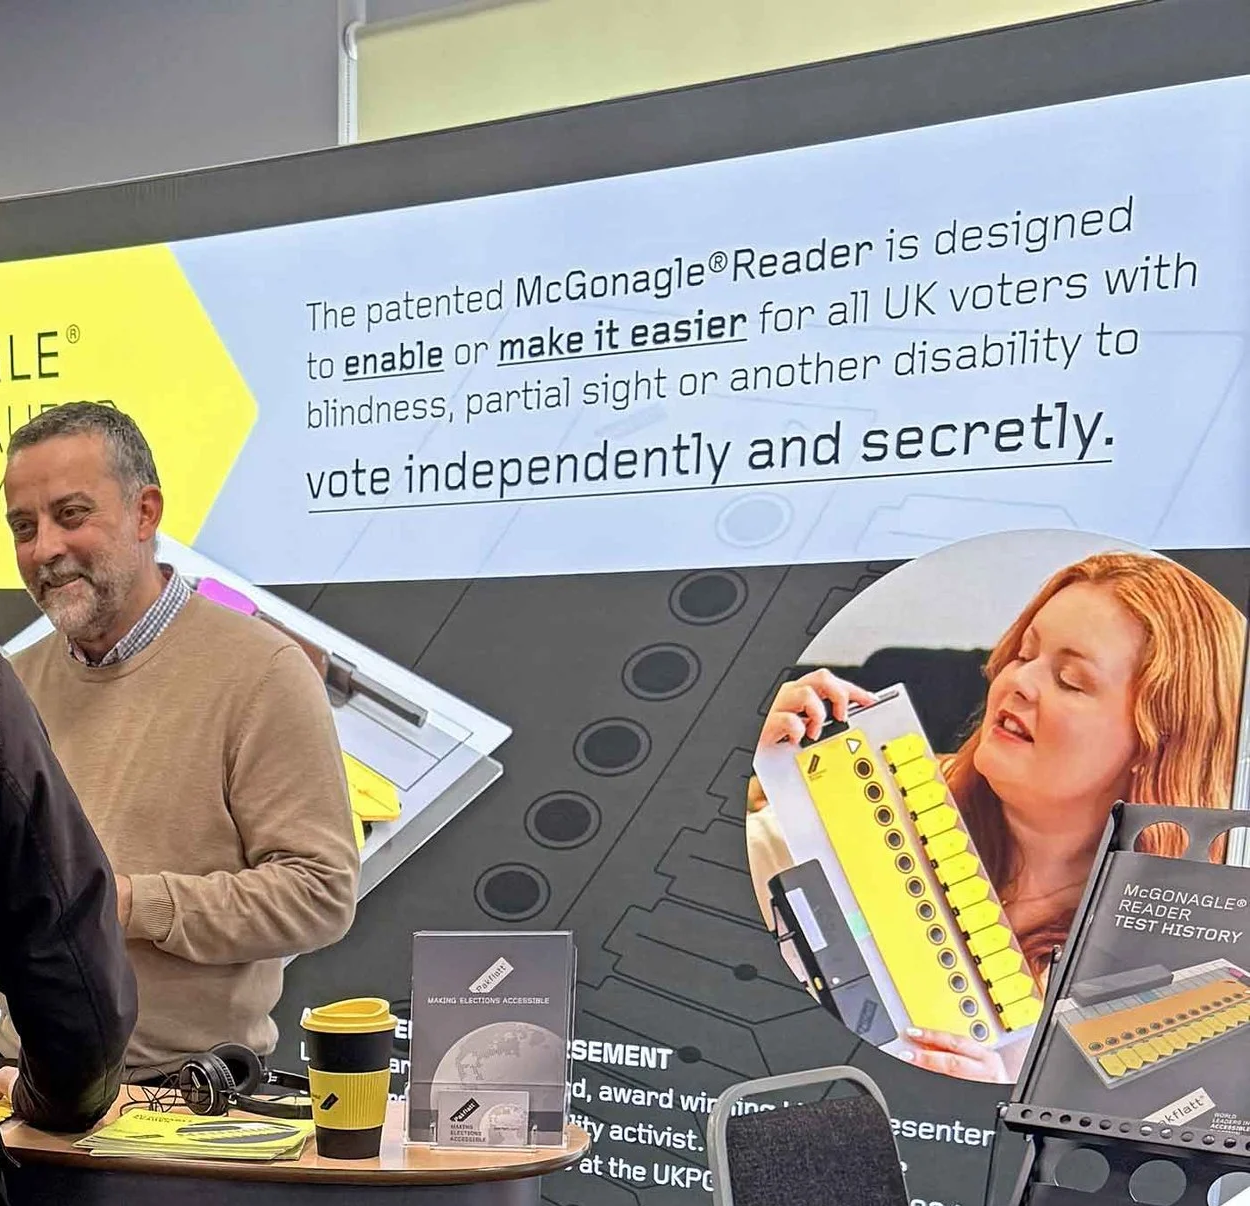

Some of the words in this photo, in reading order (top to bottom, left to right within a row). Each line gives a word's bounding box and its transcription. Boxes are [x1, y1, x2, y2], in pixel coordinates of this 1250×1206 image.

[306, 302, 356, 331] The
[367, 280, 503, 332] patented
[886, 229, 919, 262] is
[935, 196, 1133, 255] designed
[308, 356, 334, 379] to
[344, 341, 443, 377] enable
[455, 340, 488, 365] or
[499, 326, 584, 362] make
[595, 320, 619, 351] it
[631, 309, 747, 347] easier
[760, 302, 814, 334] for
[828, 291, 868, 326] all
[885, 281, 937, 319] UK
[950, 272, 1088, 313] voters
[1105, 253, 1197, 295] with
[307, 395, 453, 429] blindness,
[466, 378, 571, 423] partial
[583, 368, 667, 411] sight
[679, 368, 718, 396] or
[731, 352, 880, 392] another
[894, 327, 1083, 377] disability
[1096, 322, 1139, 357] to
[306, 458, 390, 499] vote
[405, 433, 731, 499] independently
[749, 420, 841, 470] and
[861, 401, 1114, 462] secretly.
[1118, 899, 1192, 922] READER
[1123, 883, 1247, 911] McGONAGLE®
[1114, 914, 1160, 932] TEST
[1161, 923, 1244, 944] HISTORY
[459, 996, 501, 1004] ELECTIONS
[502, 996, 550, 1005] ACCESSIBLE
[598, 1085, 674, 1109] award
[609, 1123, 704, 1151] activist.
[579, 1156, 604, 1176] at
[609, 1157, 647, 1181] the
